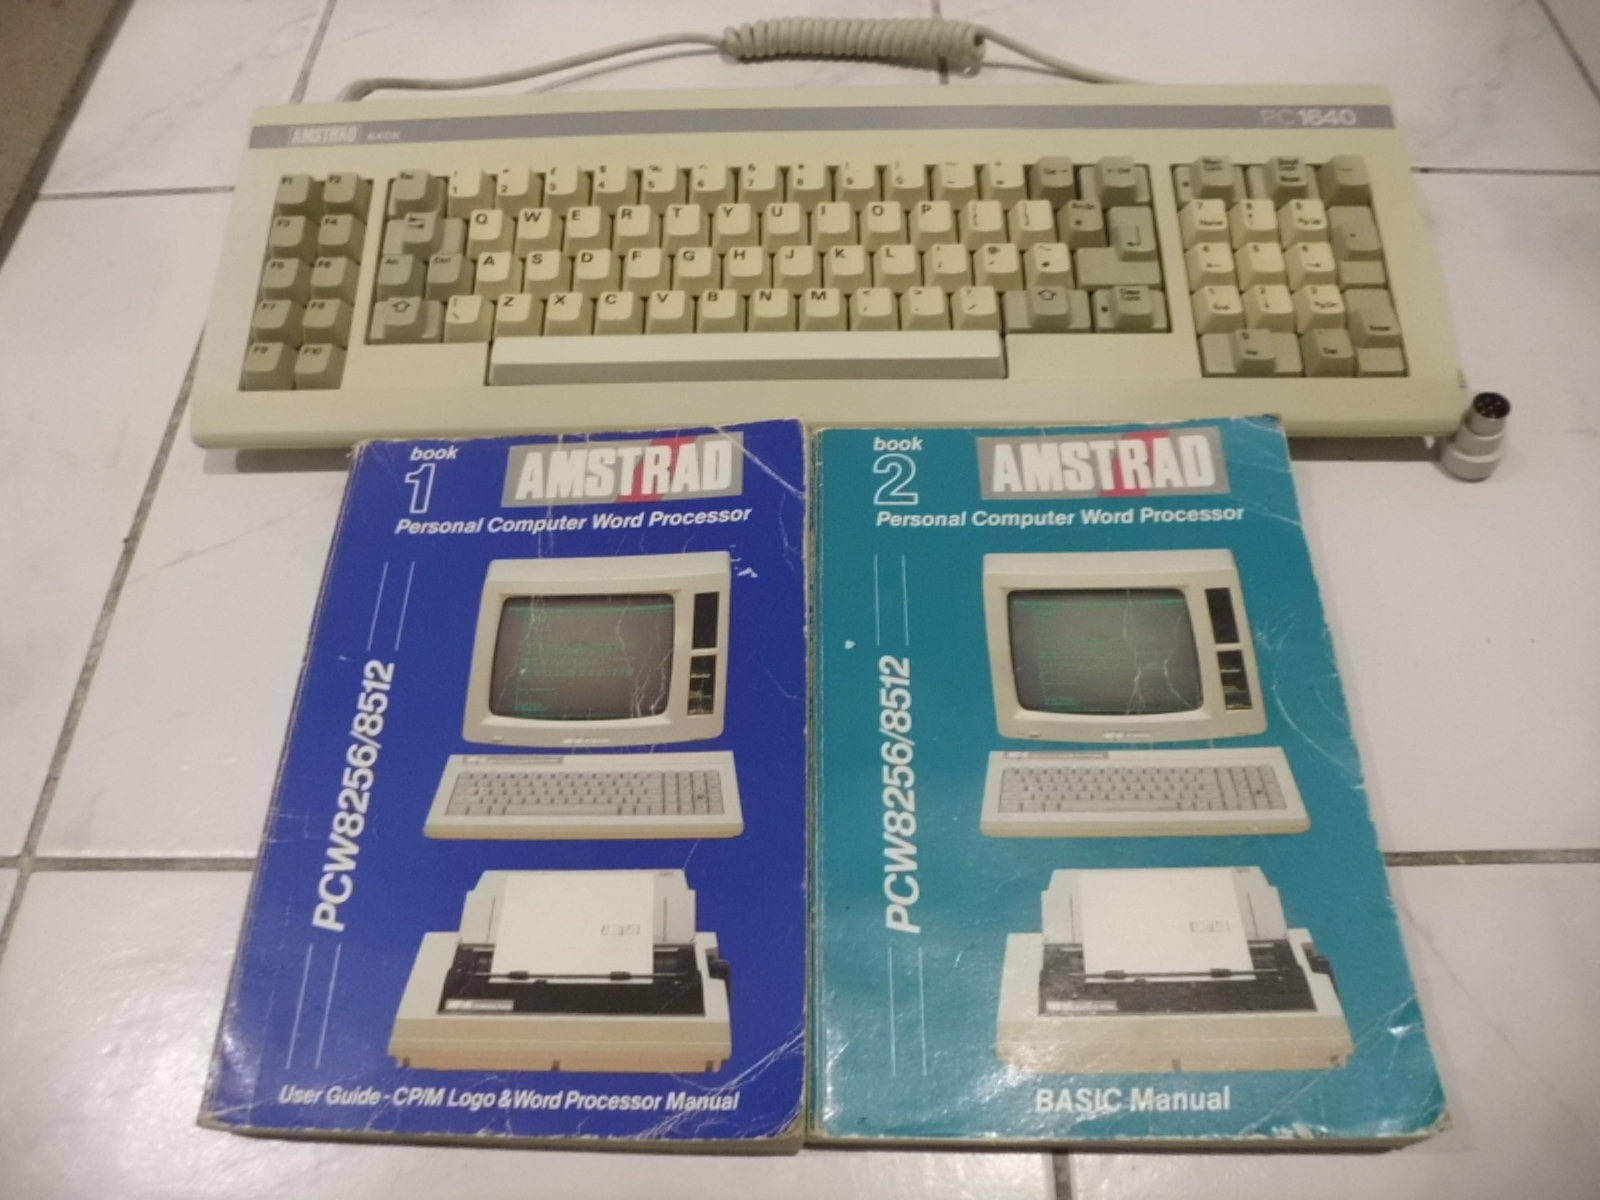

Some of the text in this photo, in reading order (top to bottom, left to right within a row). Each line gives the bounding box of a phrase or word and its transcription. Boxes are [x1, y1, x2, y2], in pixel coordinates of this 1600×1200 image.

[1260, 108, 1357, 127] PC1640
[291, 127, 358, 143] AMSTRAD
[621, 209, 633, 219] R
[672, 208, 682, 218] T
[723, 207, 734, 217] Y
[771, 206, 783, 217] U
[872, 205, 883, 216] O
[921, 204, 932, 215] P
[475, 213, 488, 225] Q
[524, 211, 542, 222] W
[571, 210, 581, 221] E
[325, 218, 337, 226] F4
[532, 253, 543, 264] S
[581, 252, 594, 263] D
[632, 251, 642, 261] F
[683, 250, 695, 262] G
[733, 250, 745, 260] H
[785, 249, 794, 259] J
[835, 248, 846, 258] K
[885, 248, 895, 258] L
[483, 255, 495, 266] A
[554, 295, 566, 305] X
[605, 294, 617, 305] C
[657, 293, 668, 303] V
[707, 292, 718, 301] B
[759, 291, 772, 301] N
[811, 290, 827, 301] M
[503, 296, 515, 307] Z
[873, 436, 923, 451] book
[409, 445, 458, 461] book
[992, 434, 1216, 493] AMSTRAD
[515, 440, 732, 500] AMSTRAD
[873, 453, 919, 505] 2
[404, 462, 436, 514] 1
[395, 506, 752, 535] Personal Computer Word Processor
[876, 506, 1244, 529] Personal Computer Word Processor
[312, 659, 395, 932] PCW8256/8512
[878, 655, 921, 934] PCW8256/8512
[279, 1084, 323, 1105] User
[325, 1085, 381, 1106] Guide
[393, 1087, 446, 1107] CP/M
[447, 1088, 495, 1111] Logo
[564, 1090, 663, 1110] Processor
[665, 1091, 740, 1111] Manual
[1034, 1086, 1232, 1114] BASIC Manual
